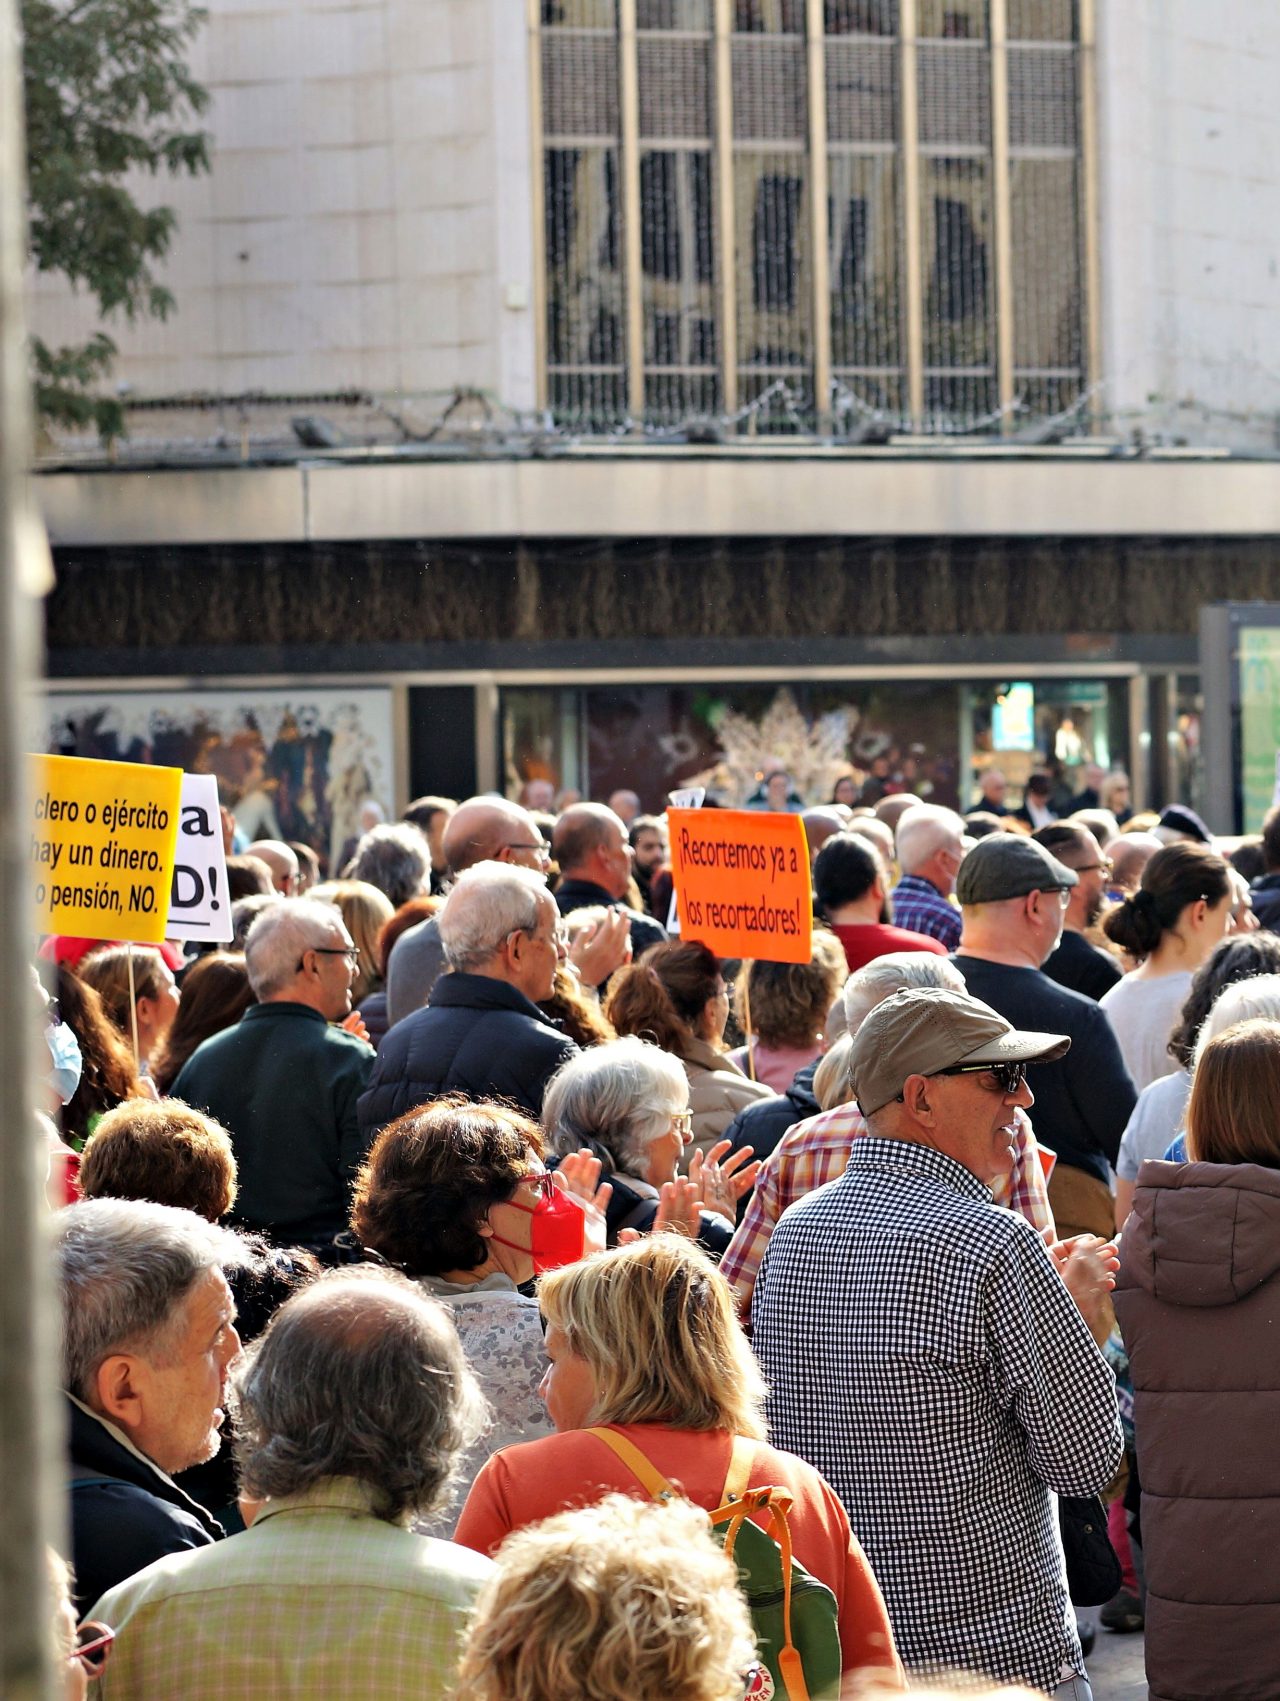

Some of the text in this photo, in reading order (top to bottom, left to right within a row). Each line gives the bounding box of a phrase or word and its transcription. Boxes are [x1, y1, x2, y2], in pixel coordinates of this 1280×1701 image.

[34, 792, 169, 833] clero o ejército
[31, 834, 163, 872] hay un dinero.
[678, 827, 798, 883] ¡Recortemos ya a
[50, 881, 123, 916] pensión,
[129, 884, 158, 913] NO.
[684, 888, 801, 936] los recortadores!
